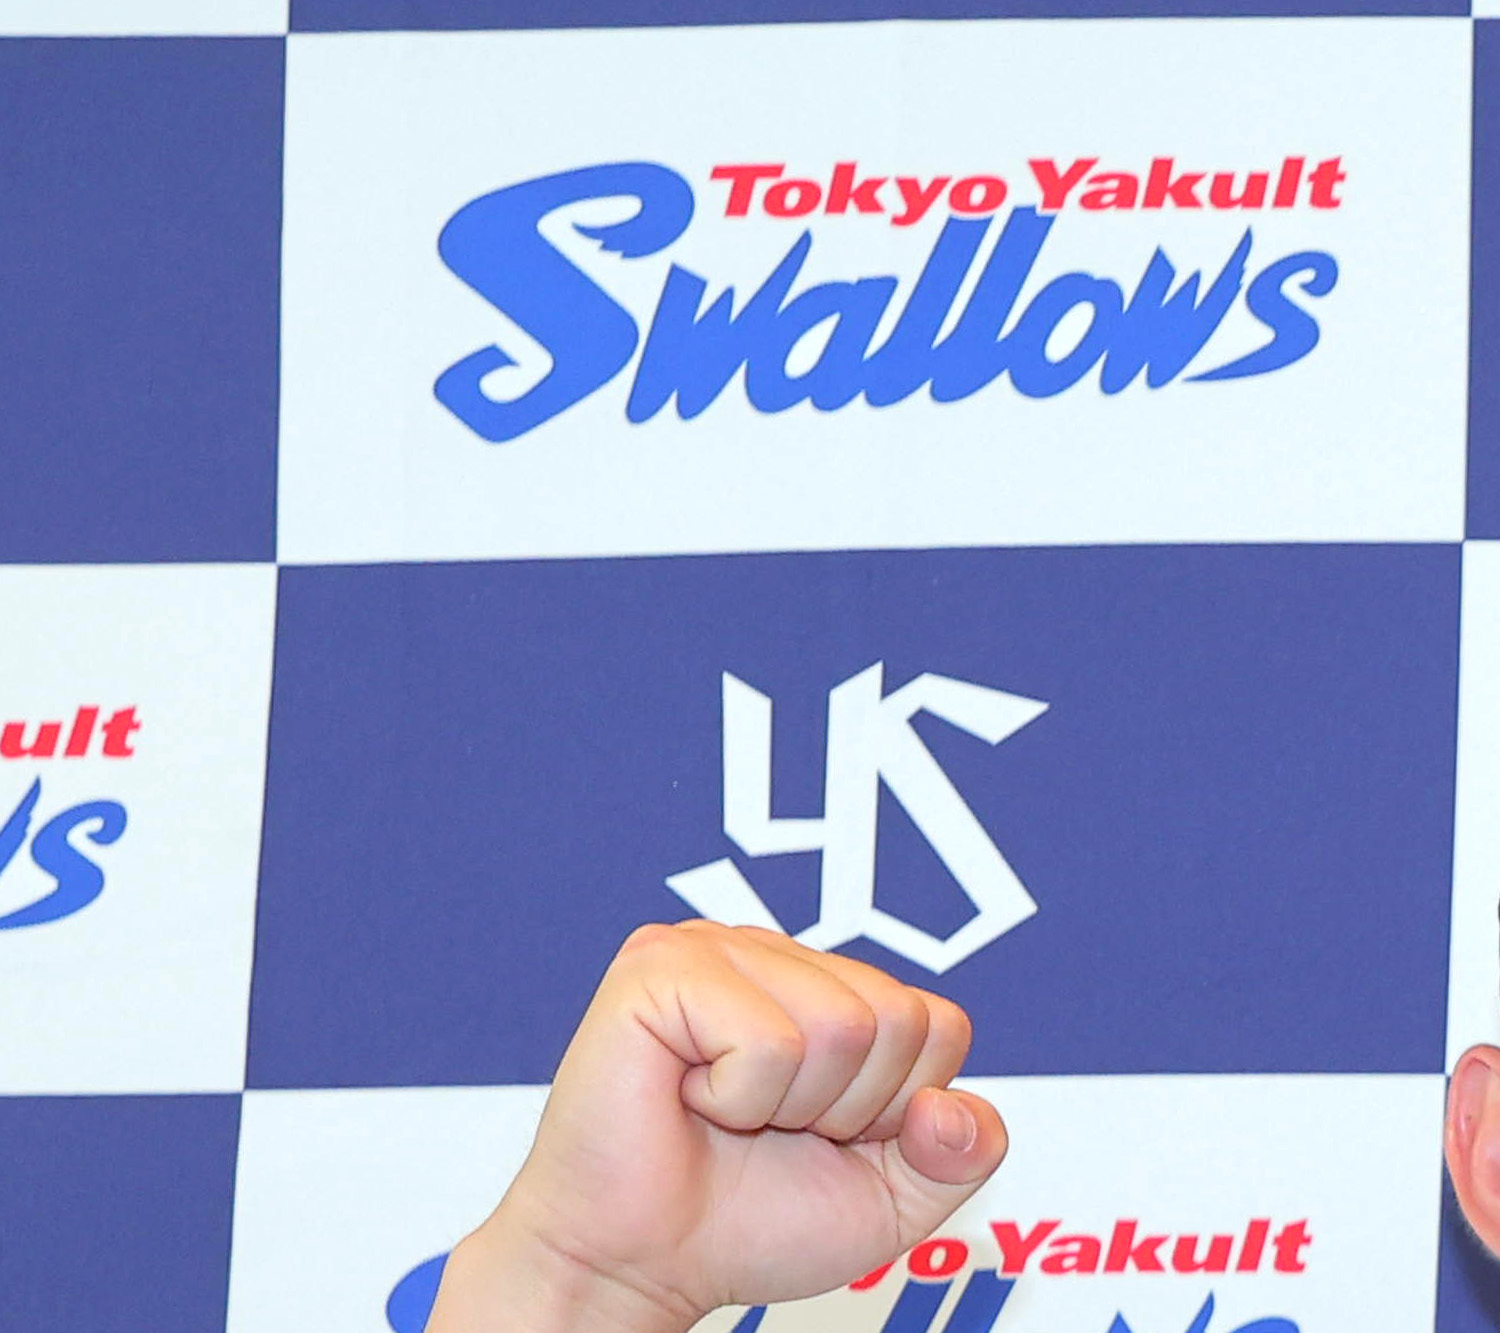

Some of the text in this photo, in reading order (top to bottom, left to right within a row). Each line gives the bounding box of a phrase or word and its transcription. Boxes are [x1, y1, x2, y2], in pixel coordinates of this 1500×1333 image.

[711, 156, 1347, 227] Tokyo Yakult
[433, 161, 1340, 444] Swallows
[0, 705, 142, 760] ult
[989, 1218, 1312, 1276] Yakult
